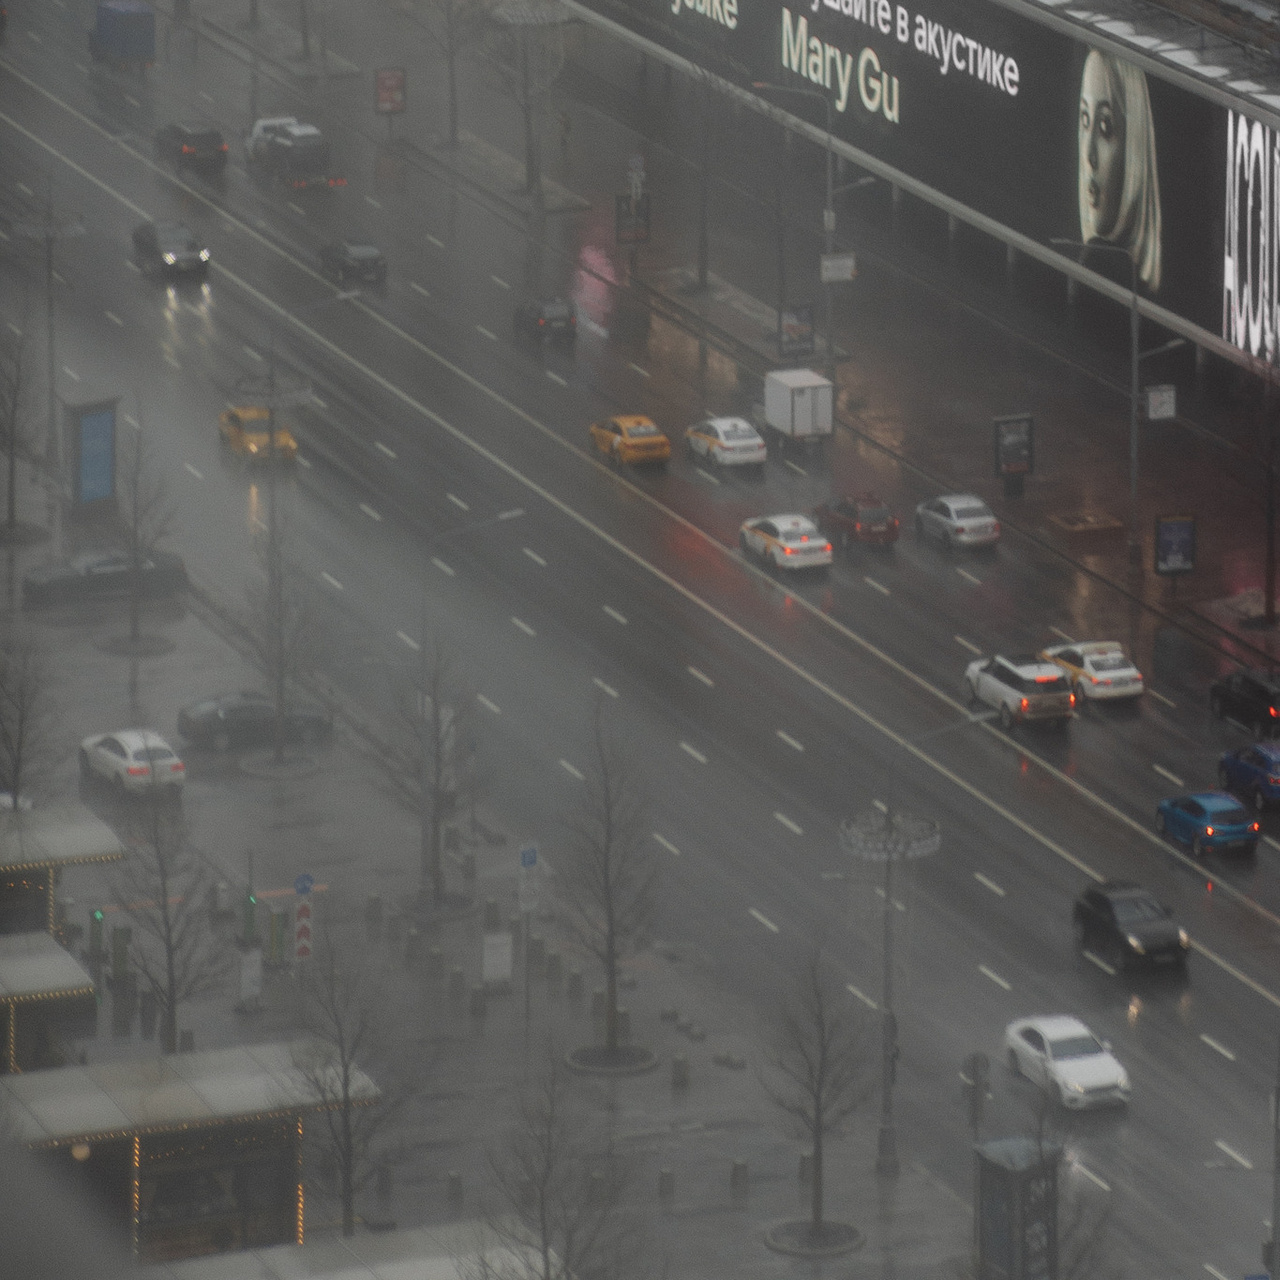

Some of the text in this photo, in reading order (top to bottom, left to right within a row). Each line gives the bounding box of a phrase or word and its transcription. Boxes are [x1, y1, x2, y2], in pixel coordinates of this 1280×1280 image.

[781, 7, 901, 125] Mary Gu
[896, 3, 909, 44] в
[914, 17, 1020, 97] акустике
